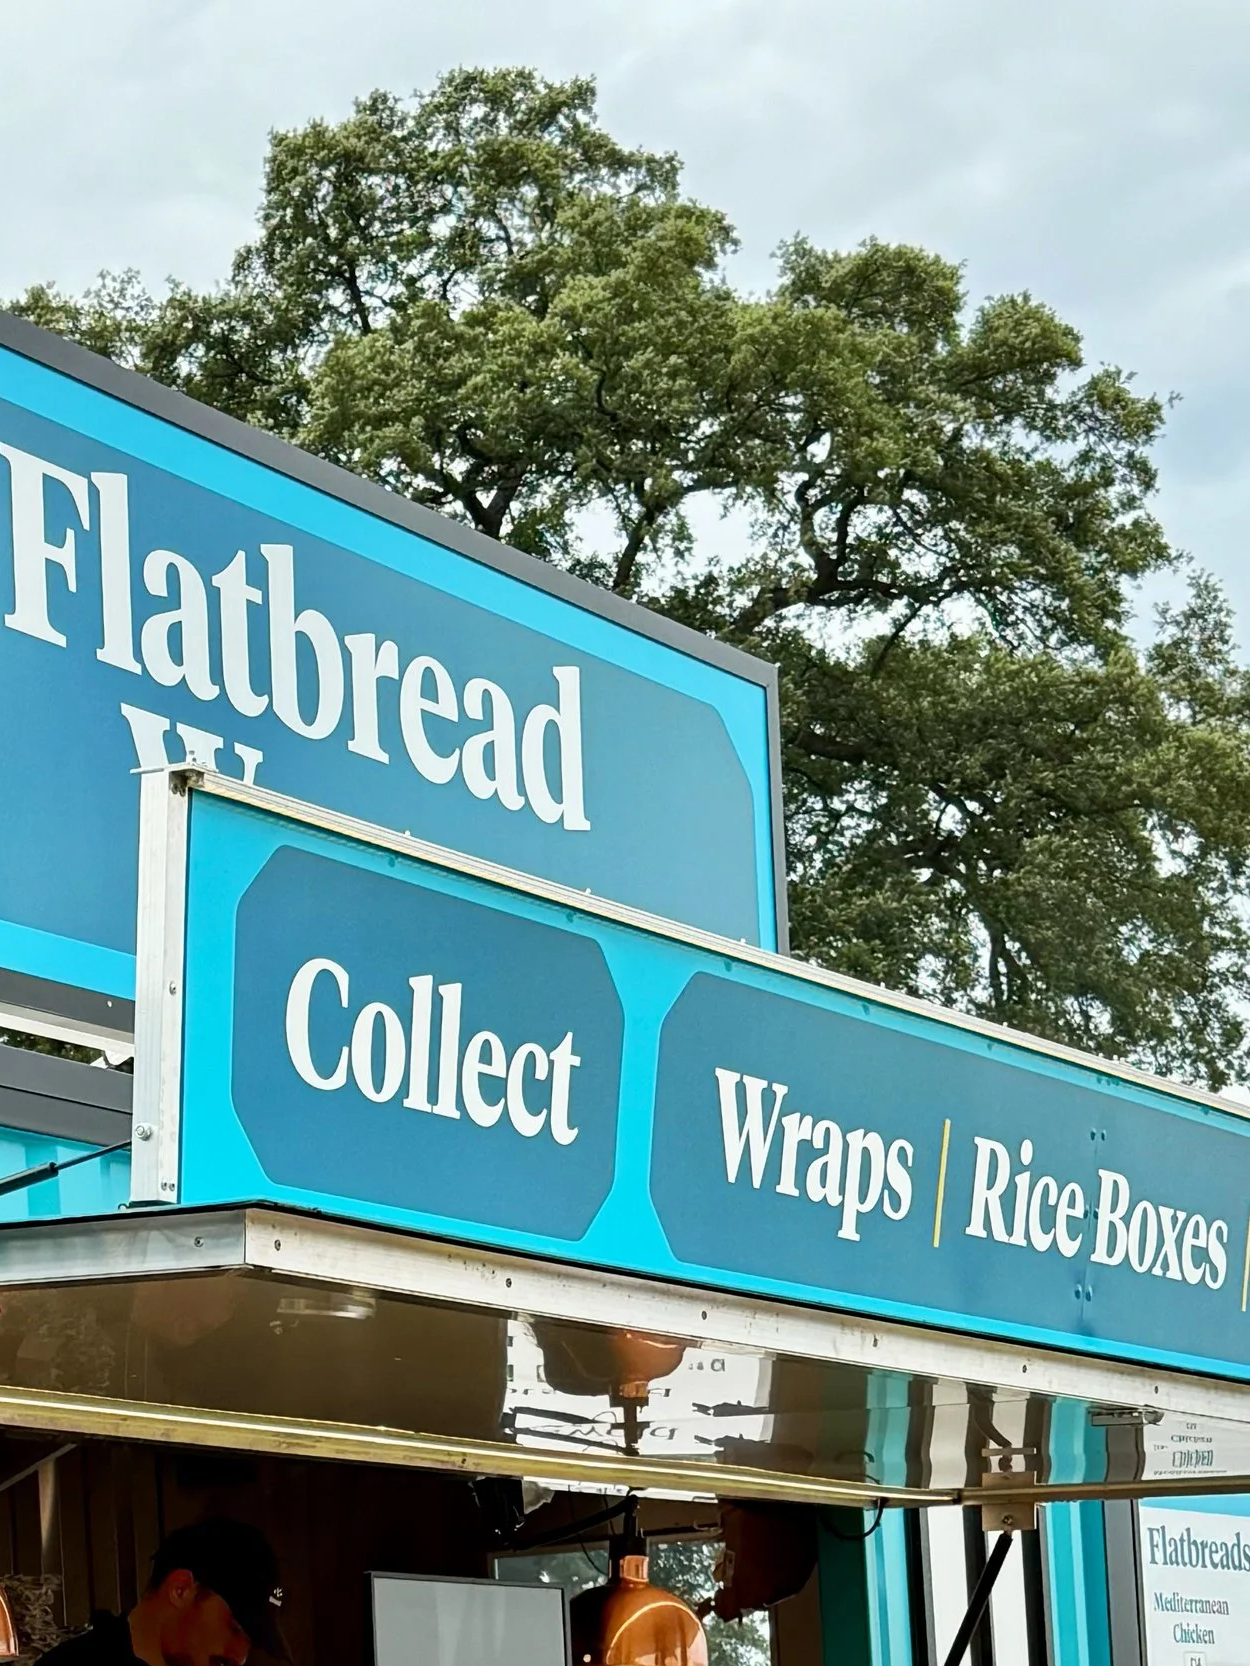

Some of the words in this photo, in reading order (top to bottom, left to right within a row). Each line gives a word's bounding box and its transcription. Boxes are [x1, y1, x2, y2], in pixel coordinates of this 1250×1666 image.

[284, 957, 581, 1146] Collect
[714, 1067, 915, 1242] Wraps
[965, 1136, 1087, 1258] Rice
[1089, 1168, 1228, 1290] Boxes
[1146, 1524, 1250, 1572] Flatbreads
[1153, 1592, 1230, 1616] Mediterranean
[1173, 1622, 1216, 1645] Chicken
